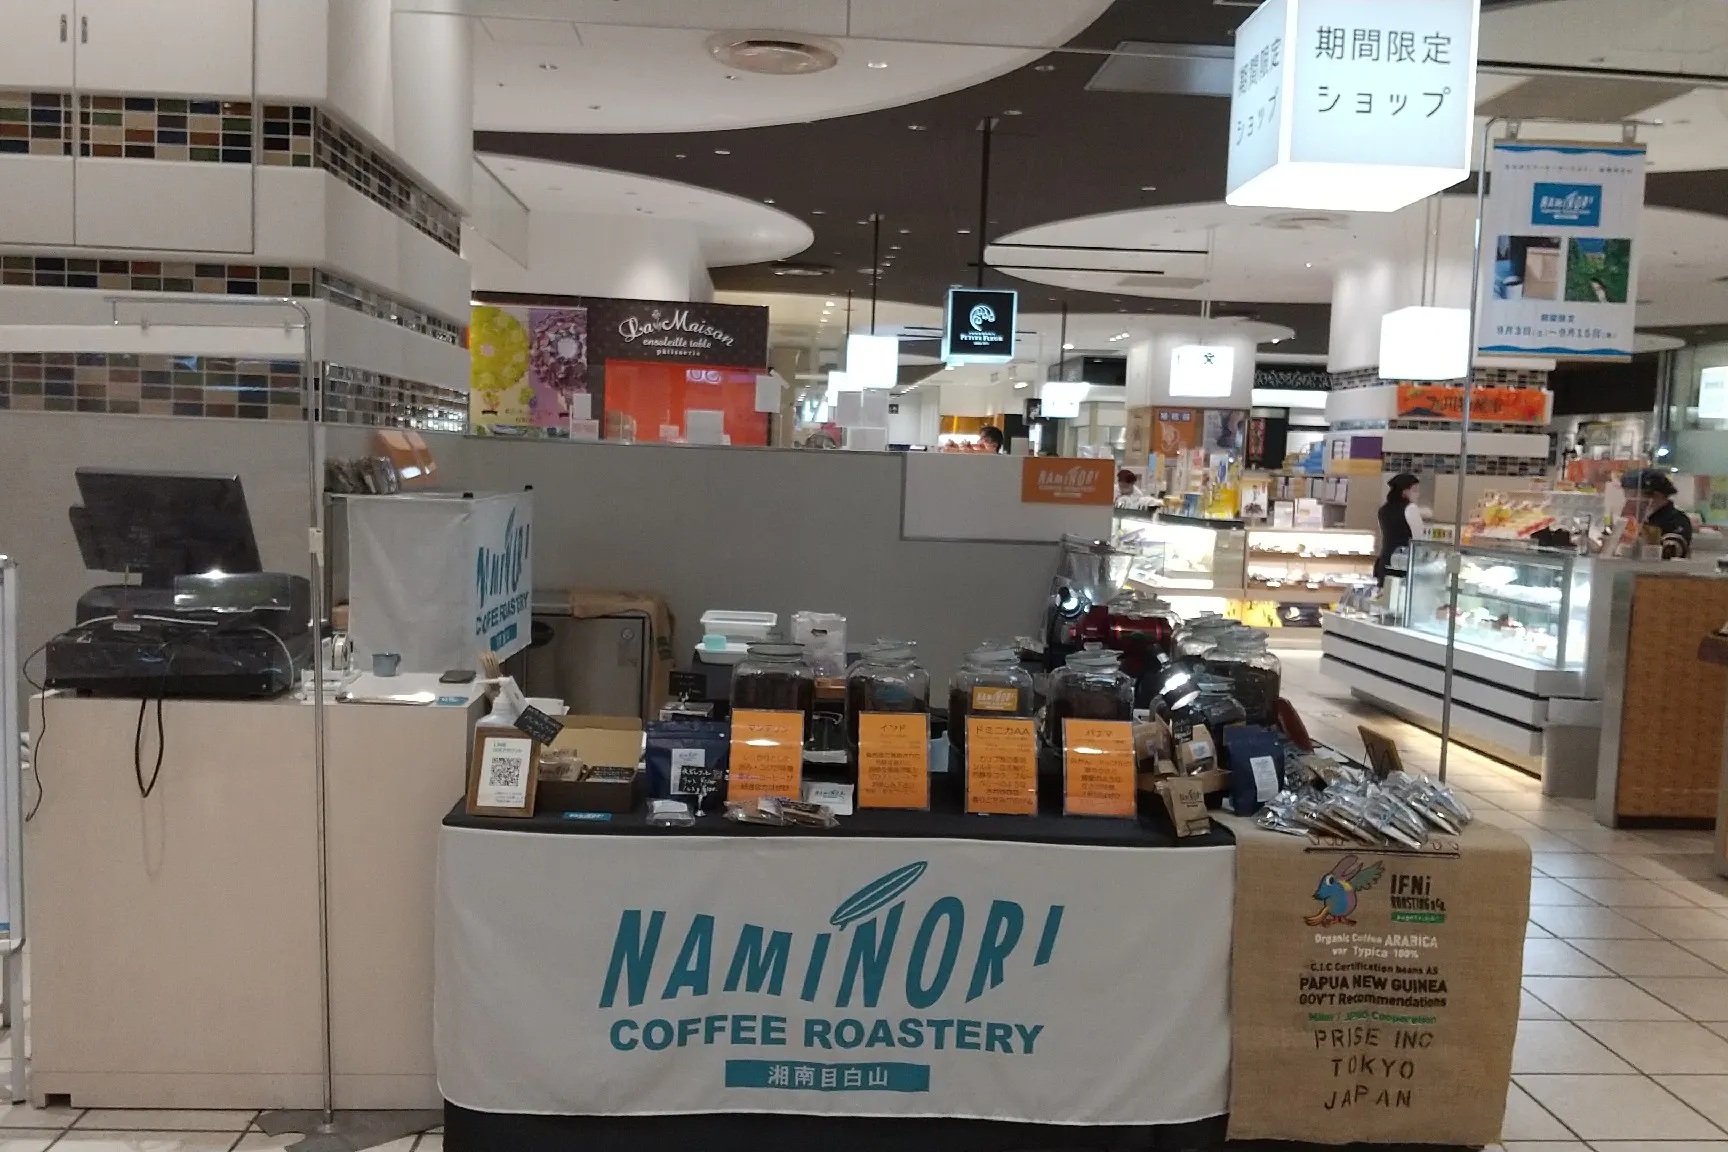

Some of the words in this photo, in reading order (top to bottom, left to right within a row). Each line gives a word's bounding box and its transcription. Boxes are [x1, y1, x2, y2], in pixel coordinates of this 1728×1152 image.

[1315, 25, 1452, 64] 期間限定
[1318, 86, 1452, 118] ショップ
[619, 317, 654, 343] La
[661, 309, 735, 347] Maison
[976, 726, 1030, 736] ドミニカAA
[1315, 933, 1350, 945] Organic
[1352, 933, 1383, 943] Coffee
[1384, 934, 1438, 948] ARABICA
[1353, 946, 1388, 958] Typica
[1394, 949, 1419, 958] 100%
[598, 896, 1066, 1010] NAMINORI
[1334, 962, 1394, 973] Certification
[1395, 966, 1424, 975] beans
[1300, 976, 1350, 991] PAPUA
[1352, 974, 1389, 990] NEW
[1391, 978, 1448, 993] GUINEA
[1338, 993, 1447, 1008] Recommendations
[609, 1014, 787, 1051] COFFEE
[803, 1017, 1044, 1055] ROASTERY
[1314, 1026, 1381, 1049] PRISE
[767, 1065, 889, 1088] 湘南目白山
[1331, 1054, 1415, 1080] TOKYO
[1324, 1084, 1411, 1110] JAPAN
